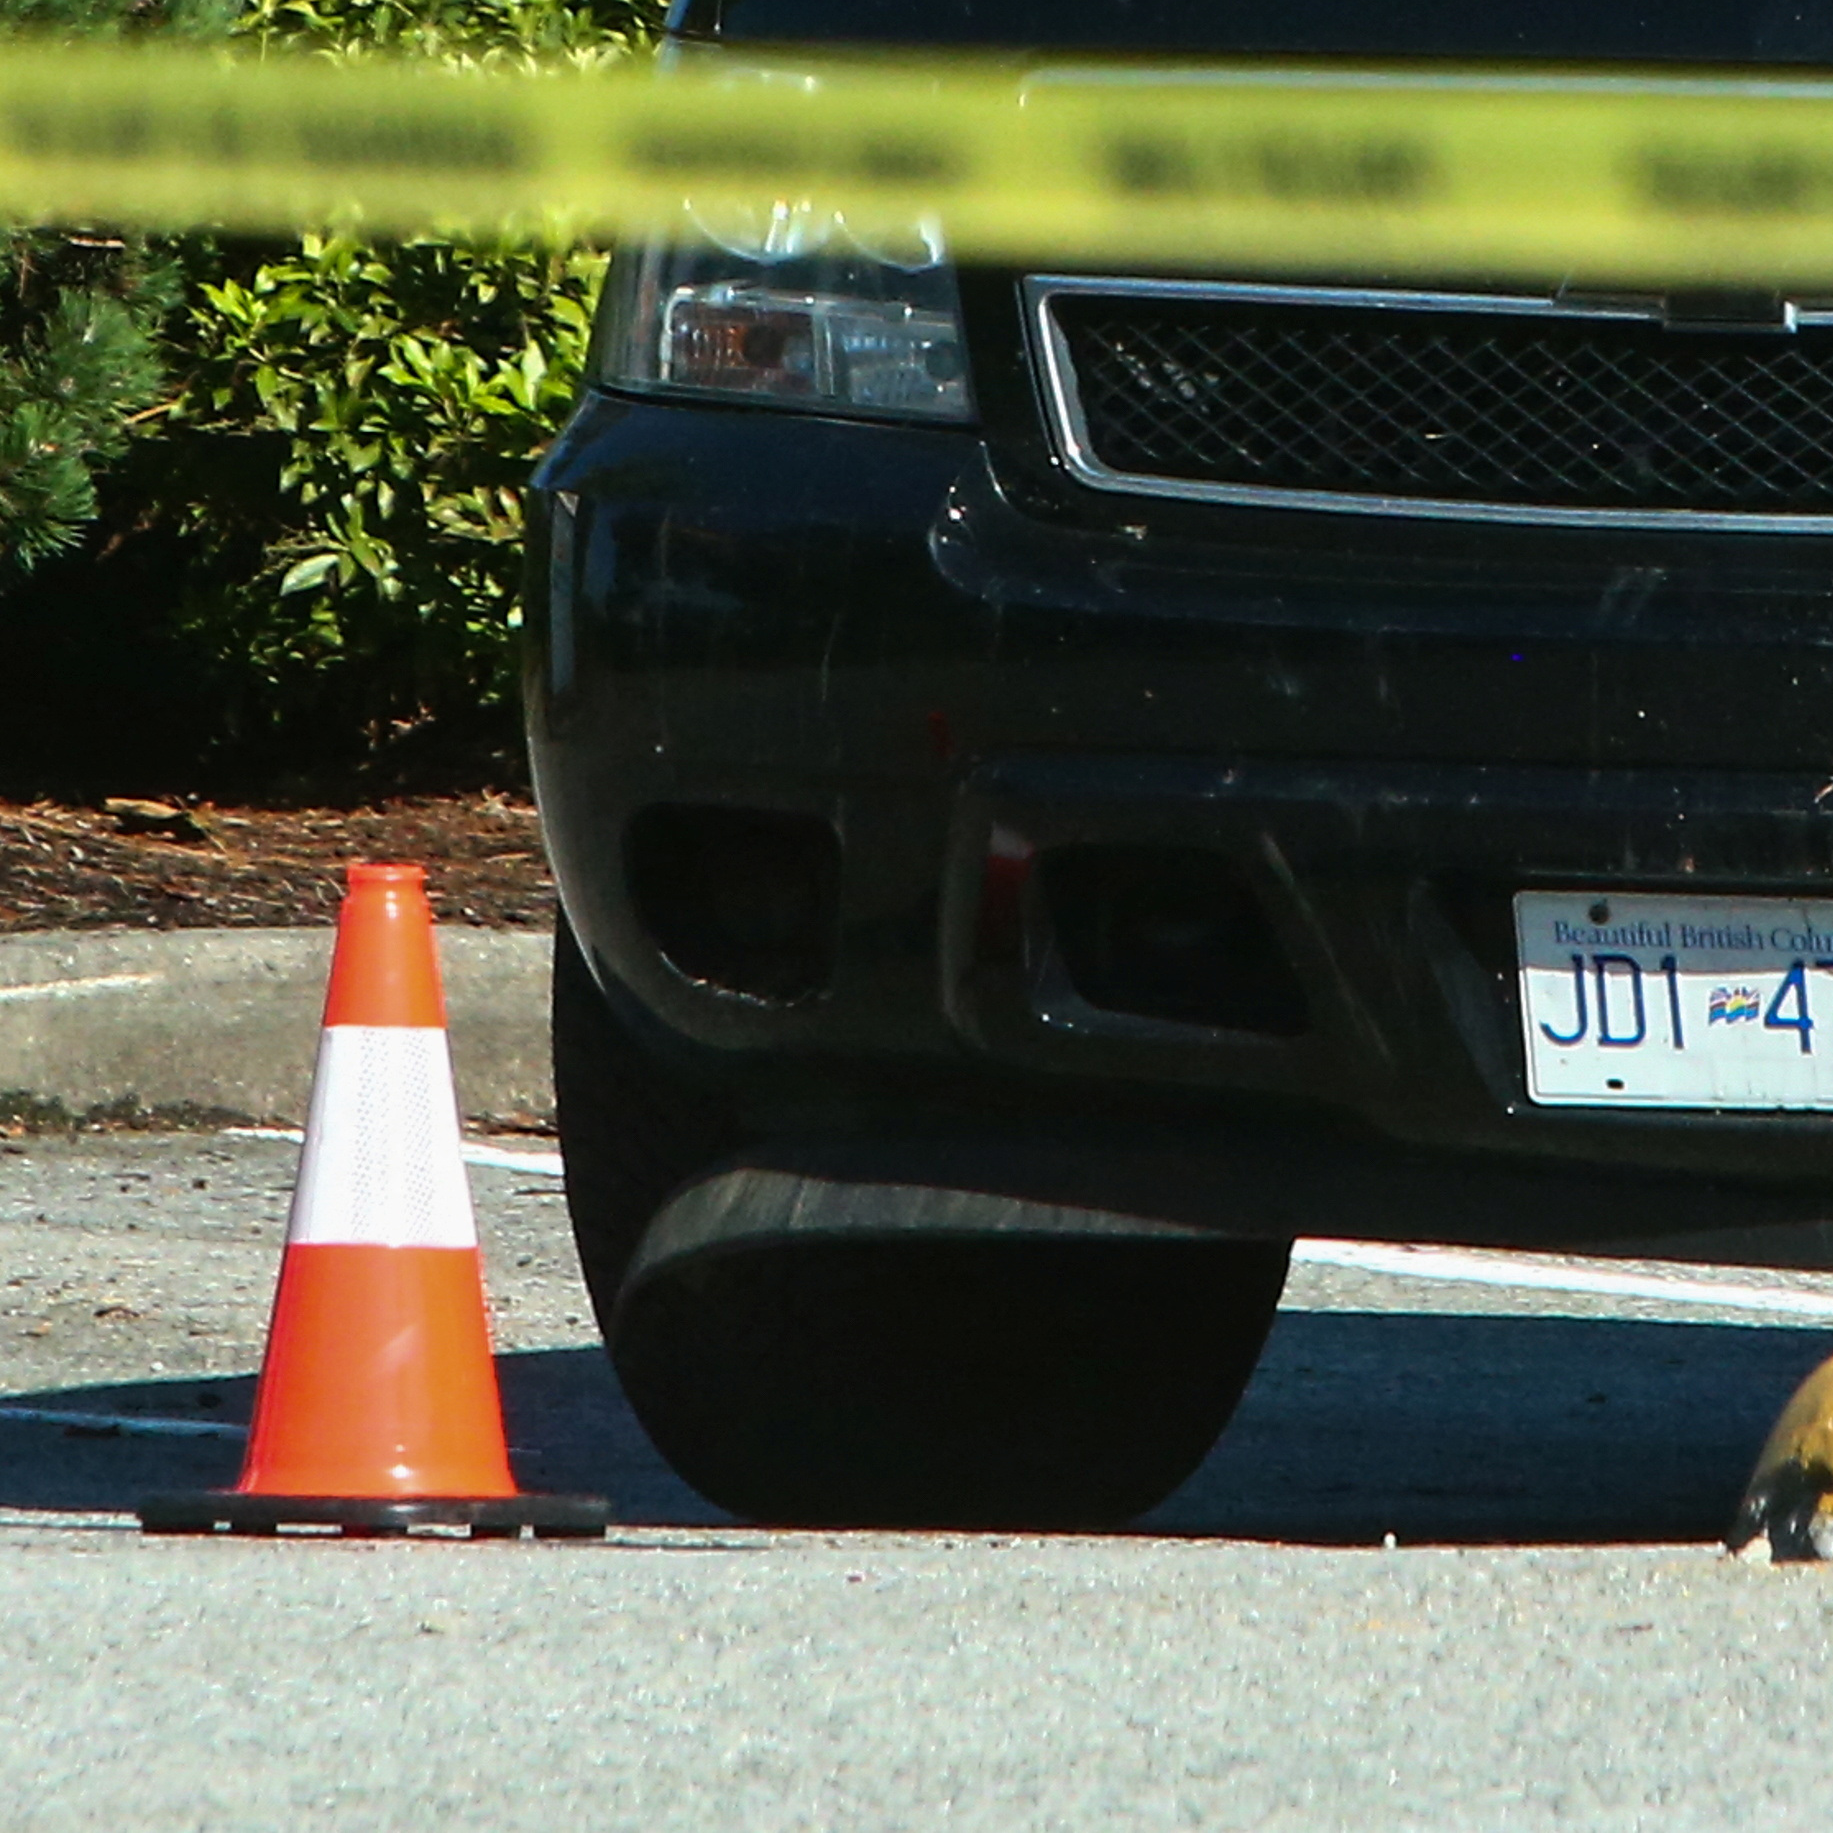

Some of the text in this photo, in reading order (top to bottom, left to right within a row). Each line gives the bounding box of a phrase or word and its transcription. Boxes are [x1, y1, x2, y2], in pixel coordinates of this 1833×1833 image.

[1554, 920, 1672, 948] Beautiful
[1681, 923, 1763, 951] British
[1539, 953, 1685, 1050] JD1
